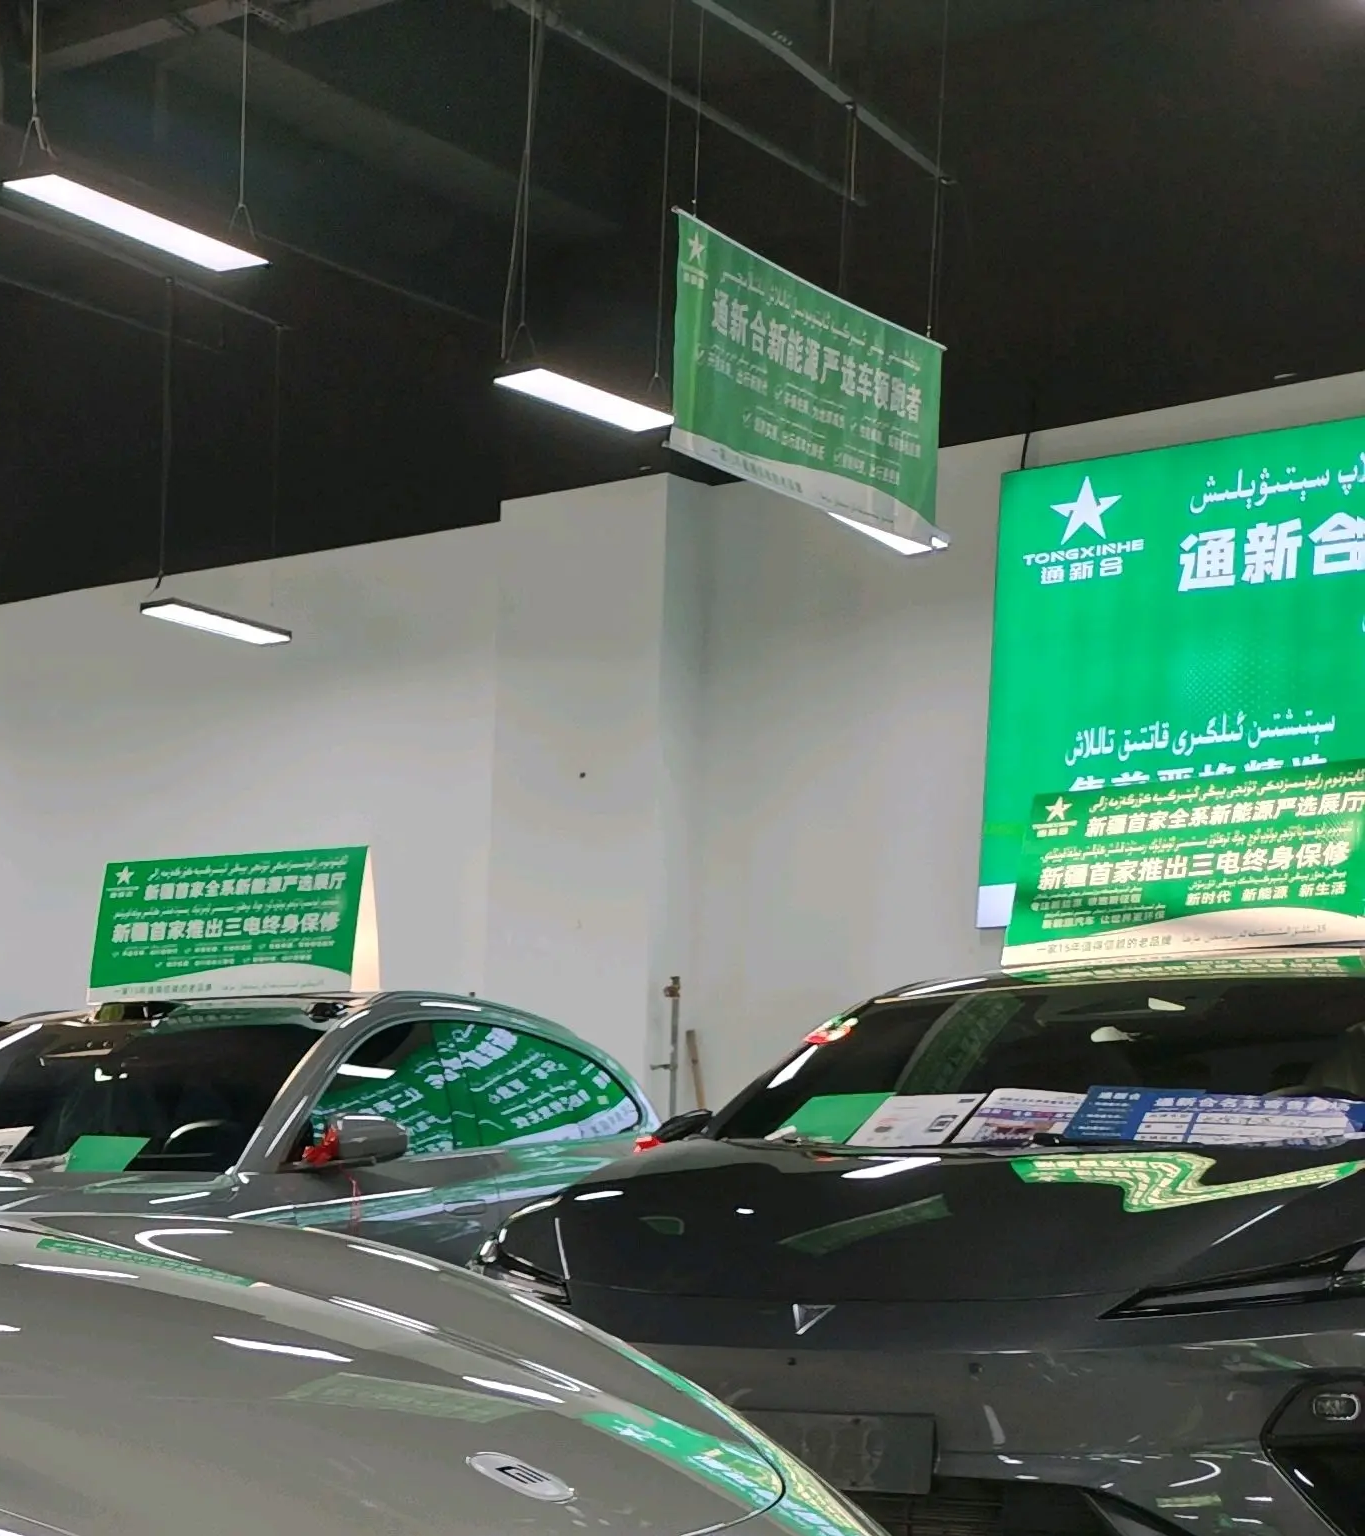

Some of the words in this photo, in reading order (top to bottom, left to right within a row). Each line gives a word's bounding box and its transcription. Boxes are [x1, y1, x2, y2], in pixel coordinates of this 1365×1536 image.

[711, 287, 922, 425] 通新合新能源严选车领跑者
[1023, 538, 1145, 566] TONGXINHE
[1040, 556, 1124, 585] 通新合
[1037, 840, 1351, 891] 新疆首家推出三电终身保修
[1185, 891, 1232, 906] 新时代
